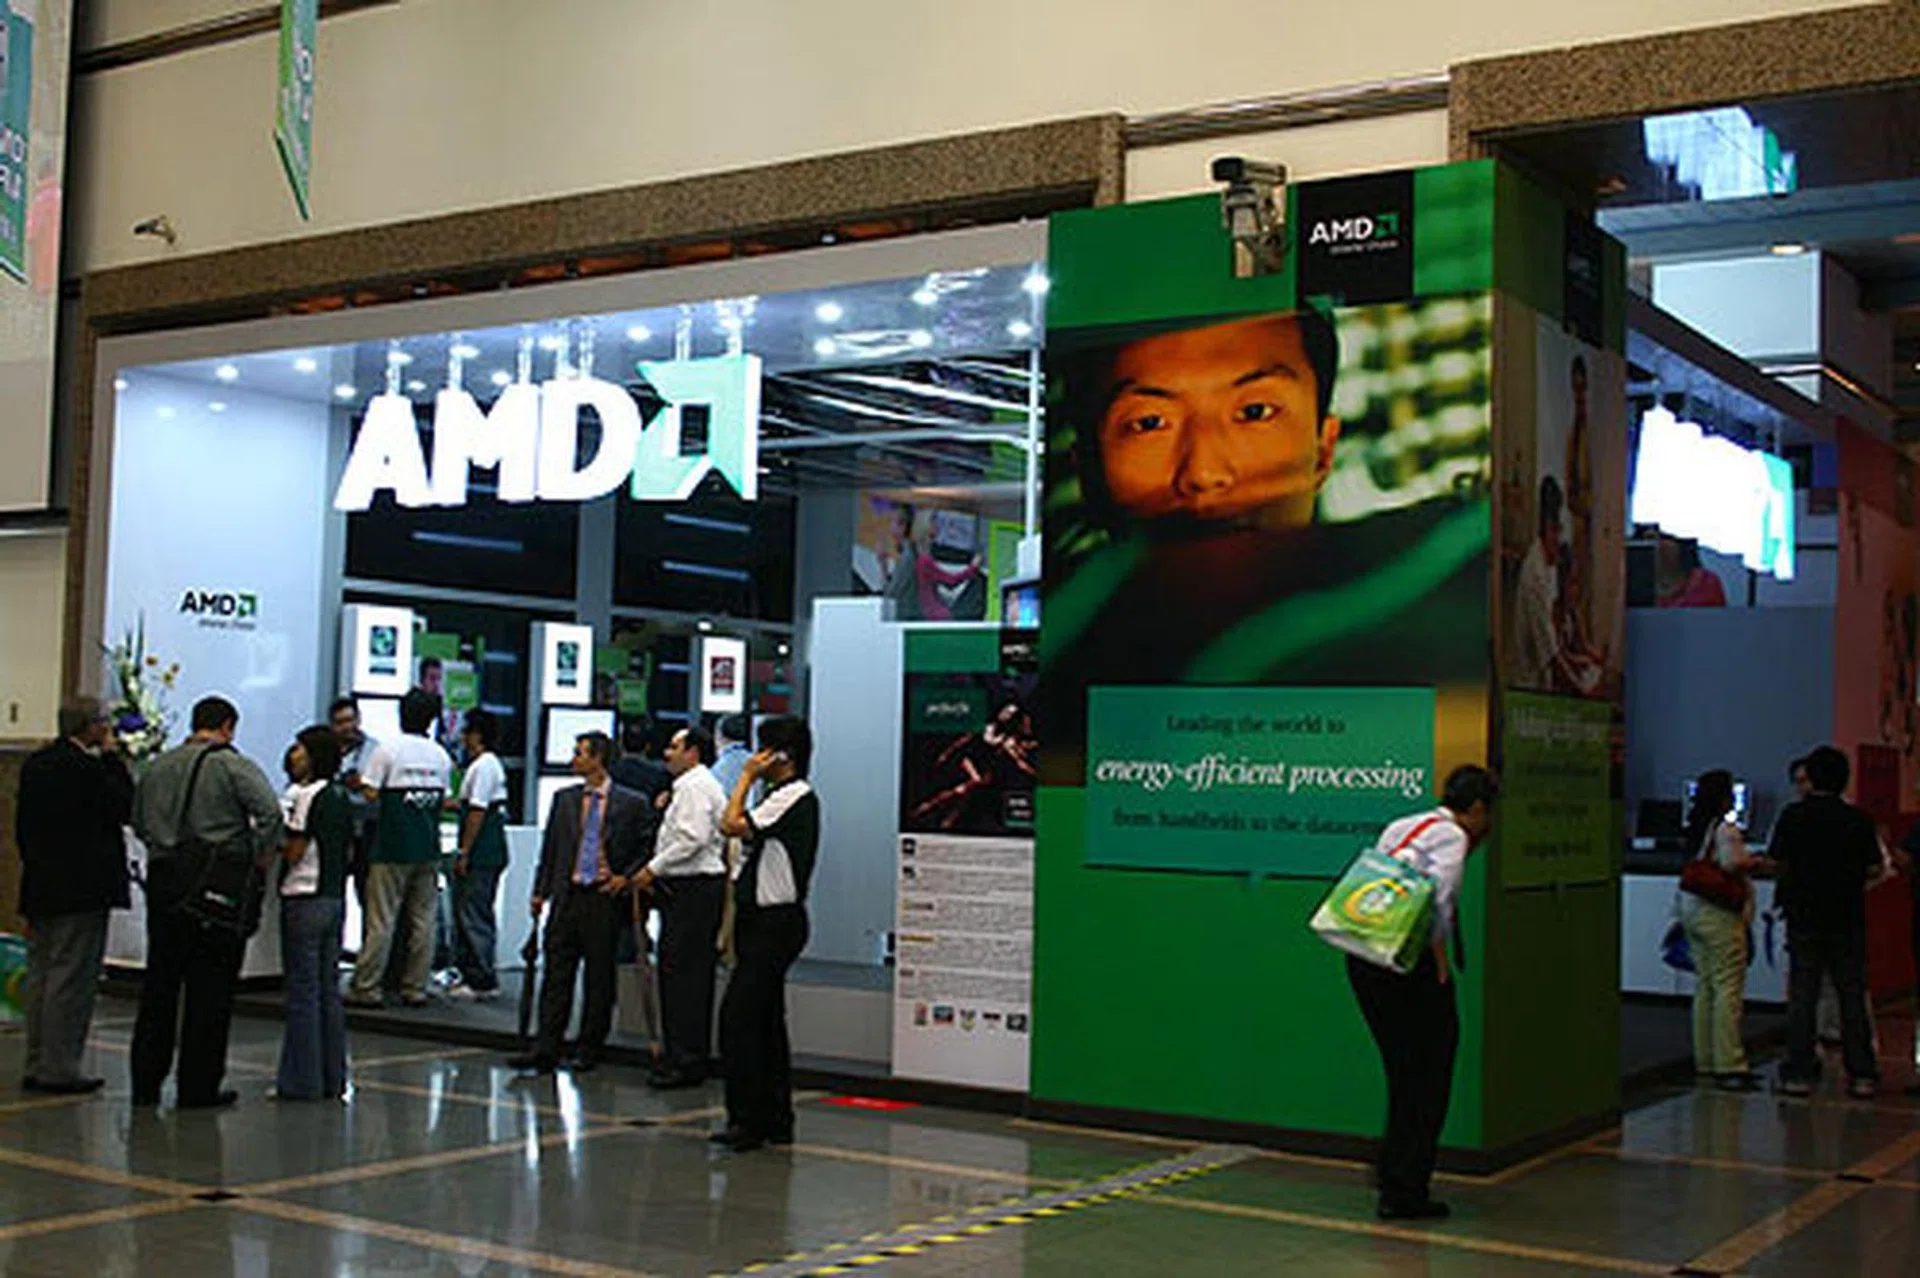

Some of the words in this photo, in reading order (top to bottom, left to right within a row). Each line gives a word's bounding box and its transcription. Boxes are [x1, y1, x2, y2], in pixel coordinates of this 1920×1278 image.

[1309, 217, 1373, 244] AMD
[334, 376, 643, 511] AMD
[181, 592, 236, 615] AMD
[1166, 714, 1233, 737] Leading
[1240, 715, 1265, 732] the
[1272, 714, 1322, 733] world
[1327, 717, 1346, 733] to
[1096, 752, 1285, 792] energy-efficient
[1287, 759, 1424, 799] processing
